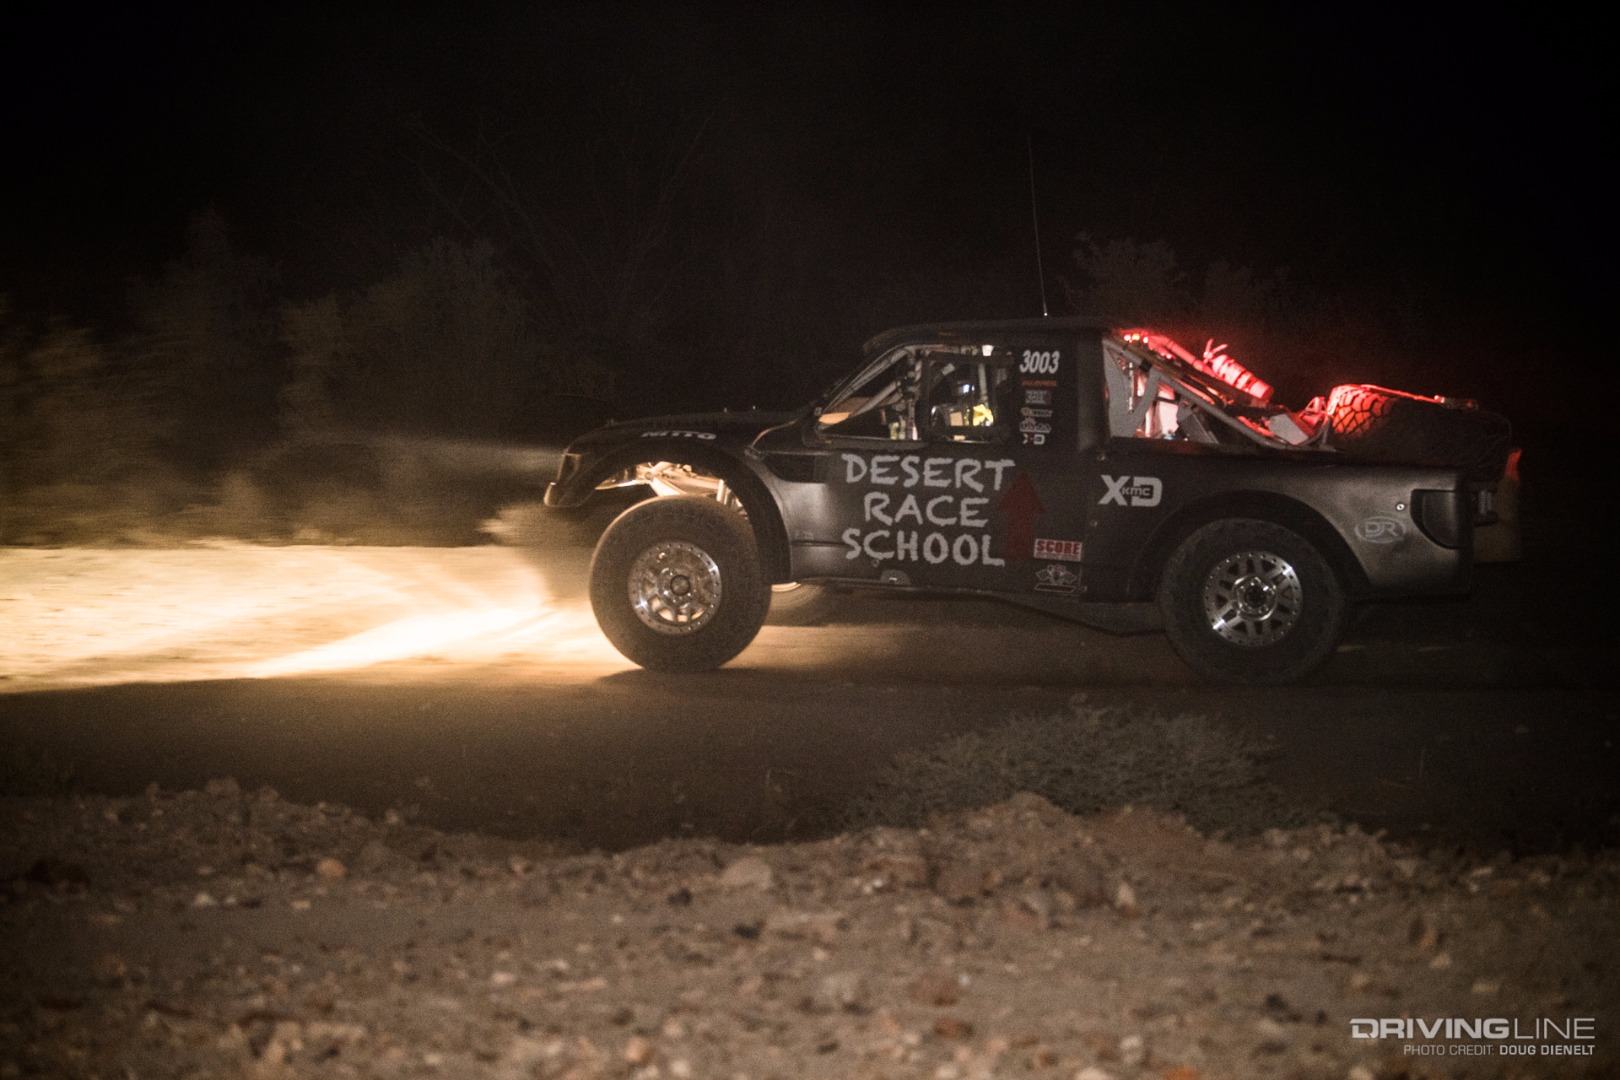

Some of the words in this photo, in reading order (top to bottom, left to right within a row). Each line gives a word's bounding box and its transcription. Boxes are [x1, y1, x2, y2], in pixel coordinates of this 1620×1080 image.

[1019, 349, 1060, 374] 3003
[841, 453, 1016, 493] DESERT
[863, 491, 989, 527] RACE
[841, 527, 1005, 568] SCHOOL
[1036, 540, 1080, 554] SCORE
